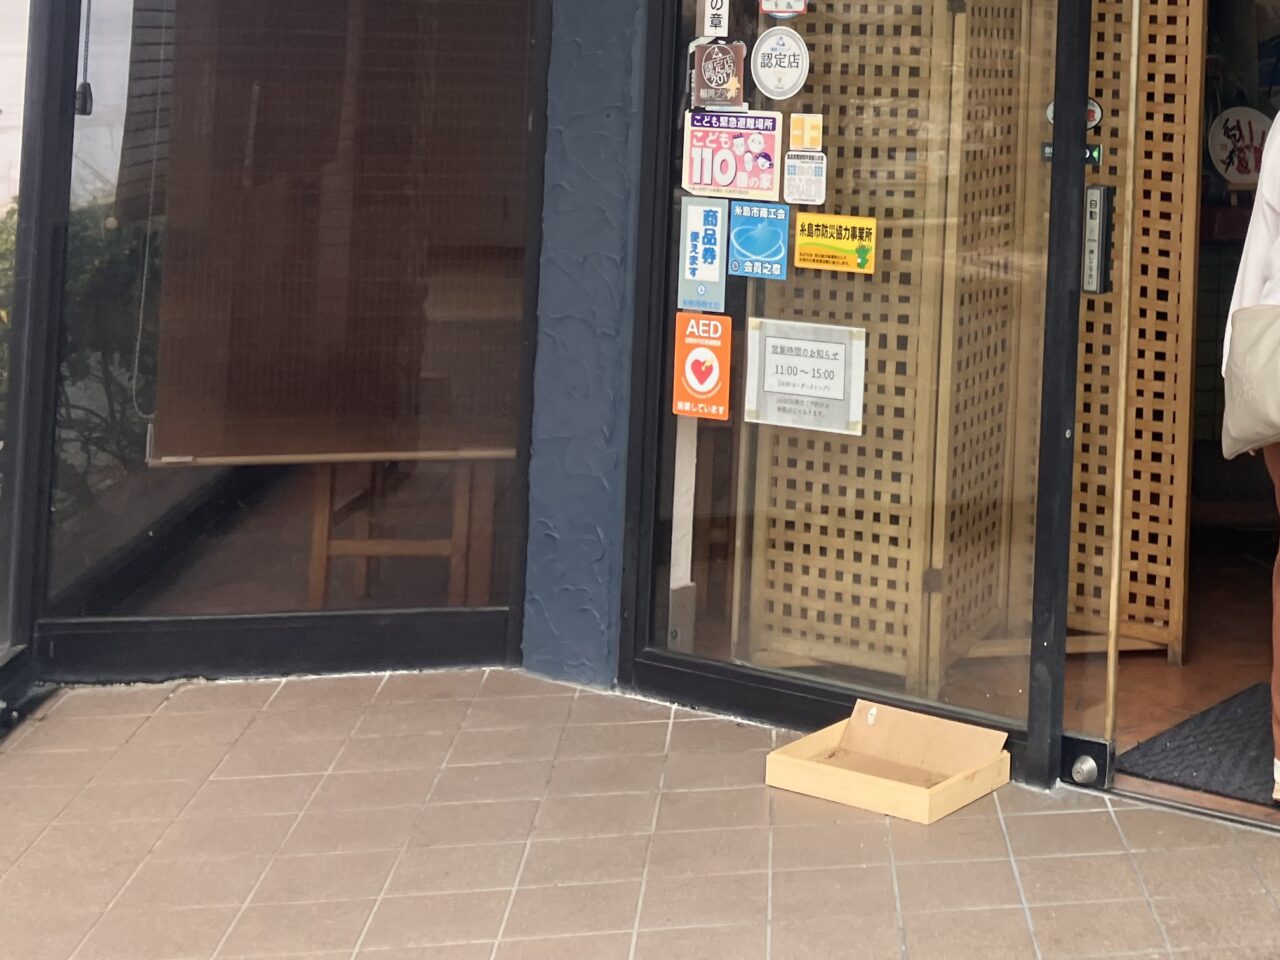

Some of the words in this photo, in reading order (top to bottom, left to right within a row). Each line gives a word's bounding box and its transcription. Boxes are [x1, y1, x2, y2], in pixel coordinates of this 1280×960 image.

[760, 52, 801, 69] 認定店
[693, 116, 774, 131] こども緊急避難場所
[693, 131, 730, 148] こども
[734, 205, 787, 220] 糸島市商工会
[701, 209, 719, 265] 商品券
[799, 221, 873, 243] 糸島市防災協力事業所
[685, 318, 722, 338] AED
